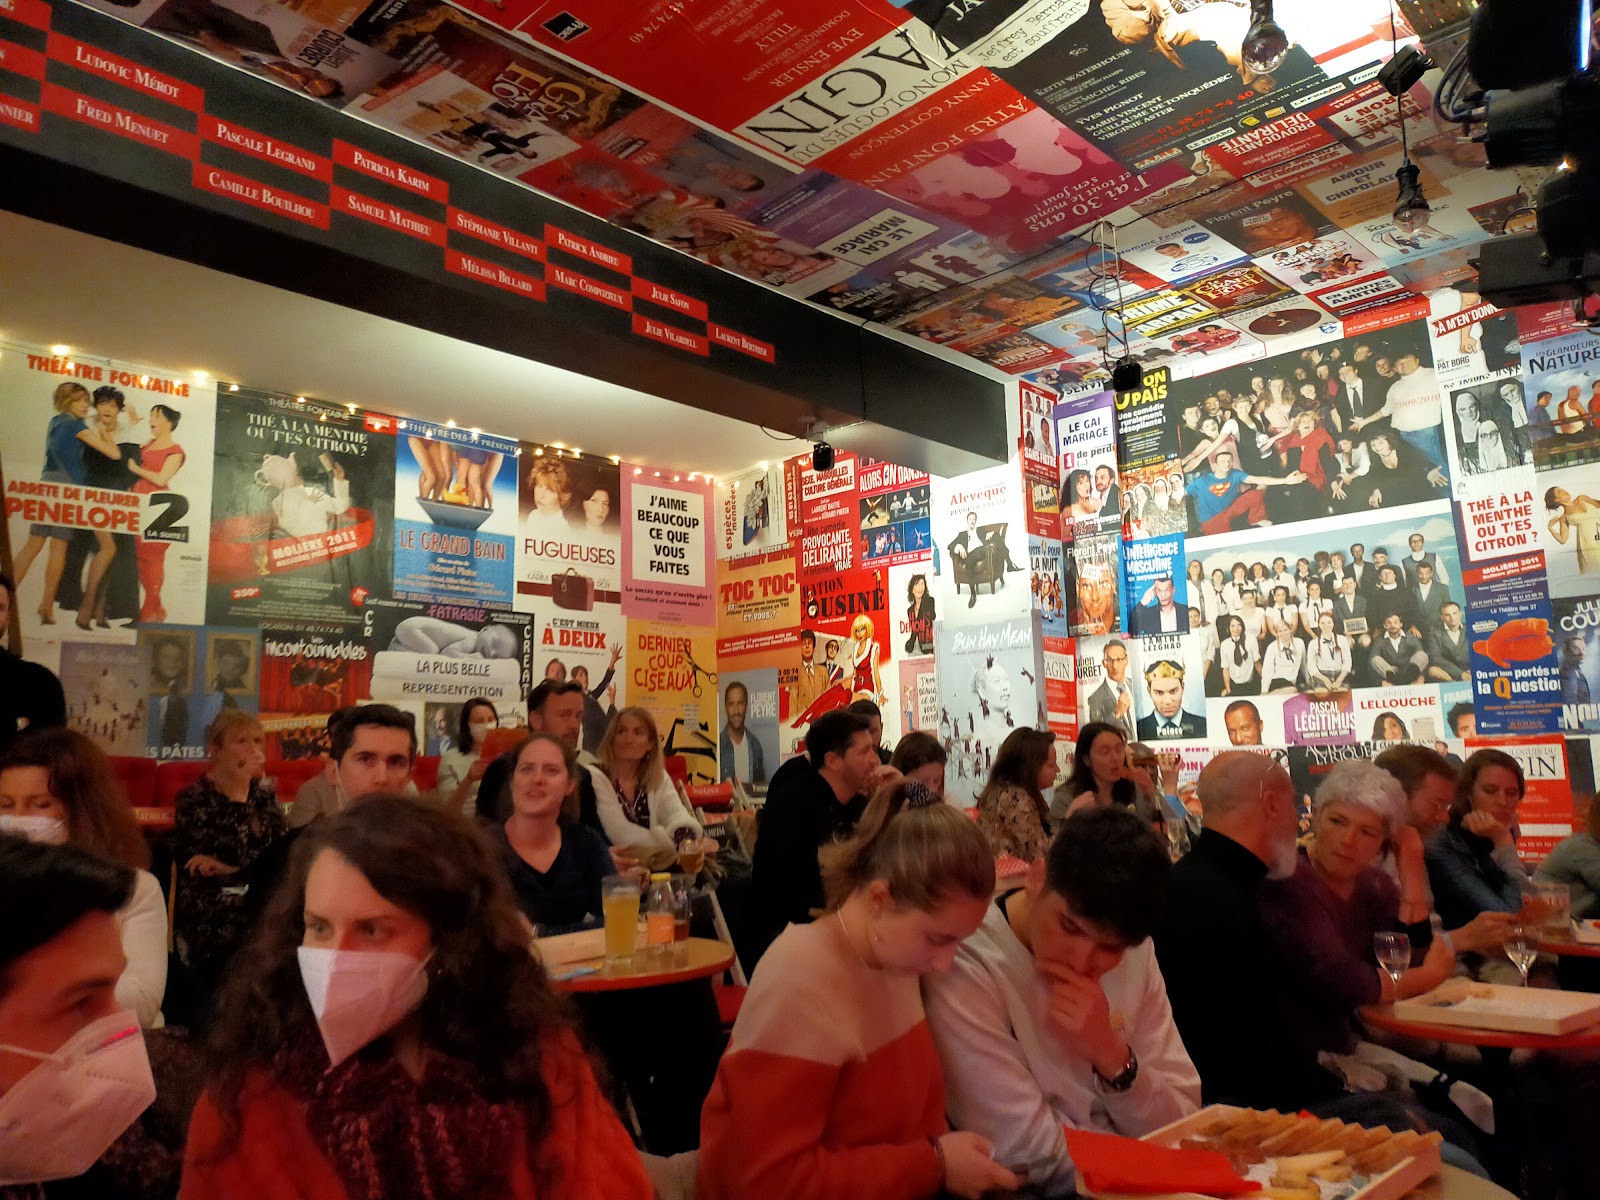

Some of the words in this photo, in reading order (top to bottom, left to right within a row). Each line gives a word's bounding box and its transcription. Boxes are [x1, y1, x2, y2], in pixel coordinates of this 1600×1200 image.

[827, 27, 864, 52] EVE
[978, 26, 1028, 63] Jeffrey
[1002, 46, 1025, 63] est
[769, 49, 831, 88] ENSLER
[1035, 79, 1064, 96] KEITH
[1064, 48, 1132, 82] WATERHOUSE
[1118, 70, 1148, 86] RIBES
[944, 73, 1000, 109] FANNY
[1076, 112, 1103, 125] YVES
[1104, 92, 1144, 114] PIGNOT
[1086, 114, 1118, 132] MARIE
[1116, 96, 1162, 120] VINCENT
[1092, 110, 1150, 137] GUILLAUME
[1098, 120, 1144, 141] VIRGINIE
[1072, 176, 1098, 192] s'en
[1085, 179, 1116, 196] tout
[1040, 186, 1072, 208] fout
[1070, 194, 1085, 204] le
[1072, 196, 1102, 216] 30
[1022, 200, 1068, 225] monde
[1028, 212, 1066, 232] ans
[1206, 206, 1252, 225] Florent
[832, 216, 907, 254] MARIAGE
[888, 228, 912, 240] LE
[858, 240, 890, 256] GAI
[1546, 340, 1600, 357] GLANDEURS
[1143, 370, 1167, 386] ON
[1118, 410, 1132, 420] Une
[1132, 402, 1165, 417] comédie
[246, 412, 276, 428] THÉ
[292, 420, 311, 434] LA
[314, 424, 368, 444] MENTHE
[1068, 422, 1080, 434] LE
[1084, 416, 1101, 429] GAI
[246, 426, 268, 440] OU
[306, 435, 359, 456] CITRON
[1062, 426, 1108, 446] MARIAGE
[1076, 448, 1088, 458] de
[860, 468, 882, 492] ALORS
[882, 464, 896, 486] ON
[84, 488, 140, 508] PLEURER
[650, 494, 688, 512] J'AIME
[1466, 494, 1496, 512] THÉ
[1500, 492, 1510, 508] À
[1514, 490, 1534, 504] LA
[6, 496, 140, 532] PENELOPE
[148, 492, 190, 533] 2
[637, 509, 700, 530] BEAUCOUP
[1472, 504, 1533, 526] MENTHE
[648, 528, 663, 540] CE
[666, 528, 690, 544] QUE
[1477, 525, 1496, 538] OU
[1500, 518, 1532, 534] T'ES
[400, 528, 416, 550] LE
[420, 530, 470, 557] GRAND
[474, 540, 506, 561] BAIN
[802, 528, 852, 551] PROVOCANTE,
[1474, 533, 1527, 552] CITRON
[524, 538, 615, 566] FUGUEUSES
[654, 544, 686, 560] VOUS
[1047, 545, 1062, 556] POUR
[1066, 546, 1095, 558] Florent
[649, 560, 690, 576] FAITES
[1030, 558, 1041, 571] LA
[1042, 557, 1058, 572] NUIT
[720, 580, 754, 604] TOC
[758, 572, 796, 598] TOC
[576, 620, 600, 630] MIEUX
[743, 614, 752, 622] ET
[753, 610, 771, 620] VOUS
[558, 629, 606, 650] DEUX
[638, 634, 692, 654] DERNIER
[416, 660, 430, 673] LA
[433, 661, 458, 674] PLUS
[461, 664, 490, 676] BELLE
[648, 654, 684, 672] COUP
[1476, 670, 1488, 680] On
[1500, 670, 1513, 678] tous
[1514, 665, 1550, 678] portés
[634, 668, 694, 692] CISEAUX
[1477, 680, 1492, 694] la
[750, 692, 776, 704] FLORENT
[1309, 701, 1339, 715] PASCAL
[1360, 696, 1436, 710] LELLOUCHE
[750, 703, 776, 718] PEYRE
[1294, 710, 1356, 732] LÉGITIMUS
